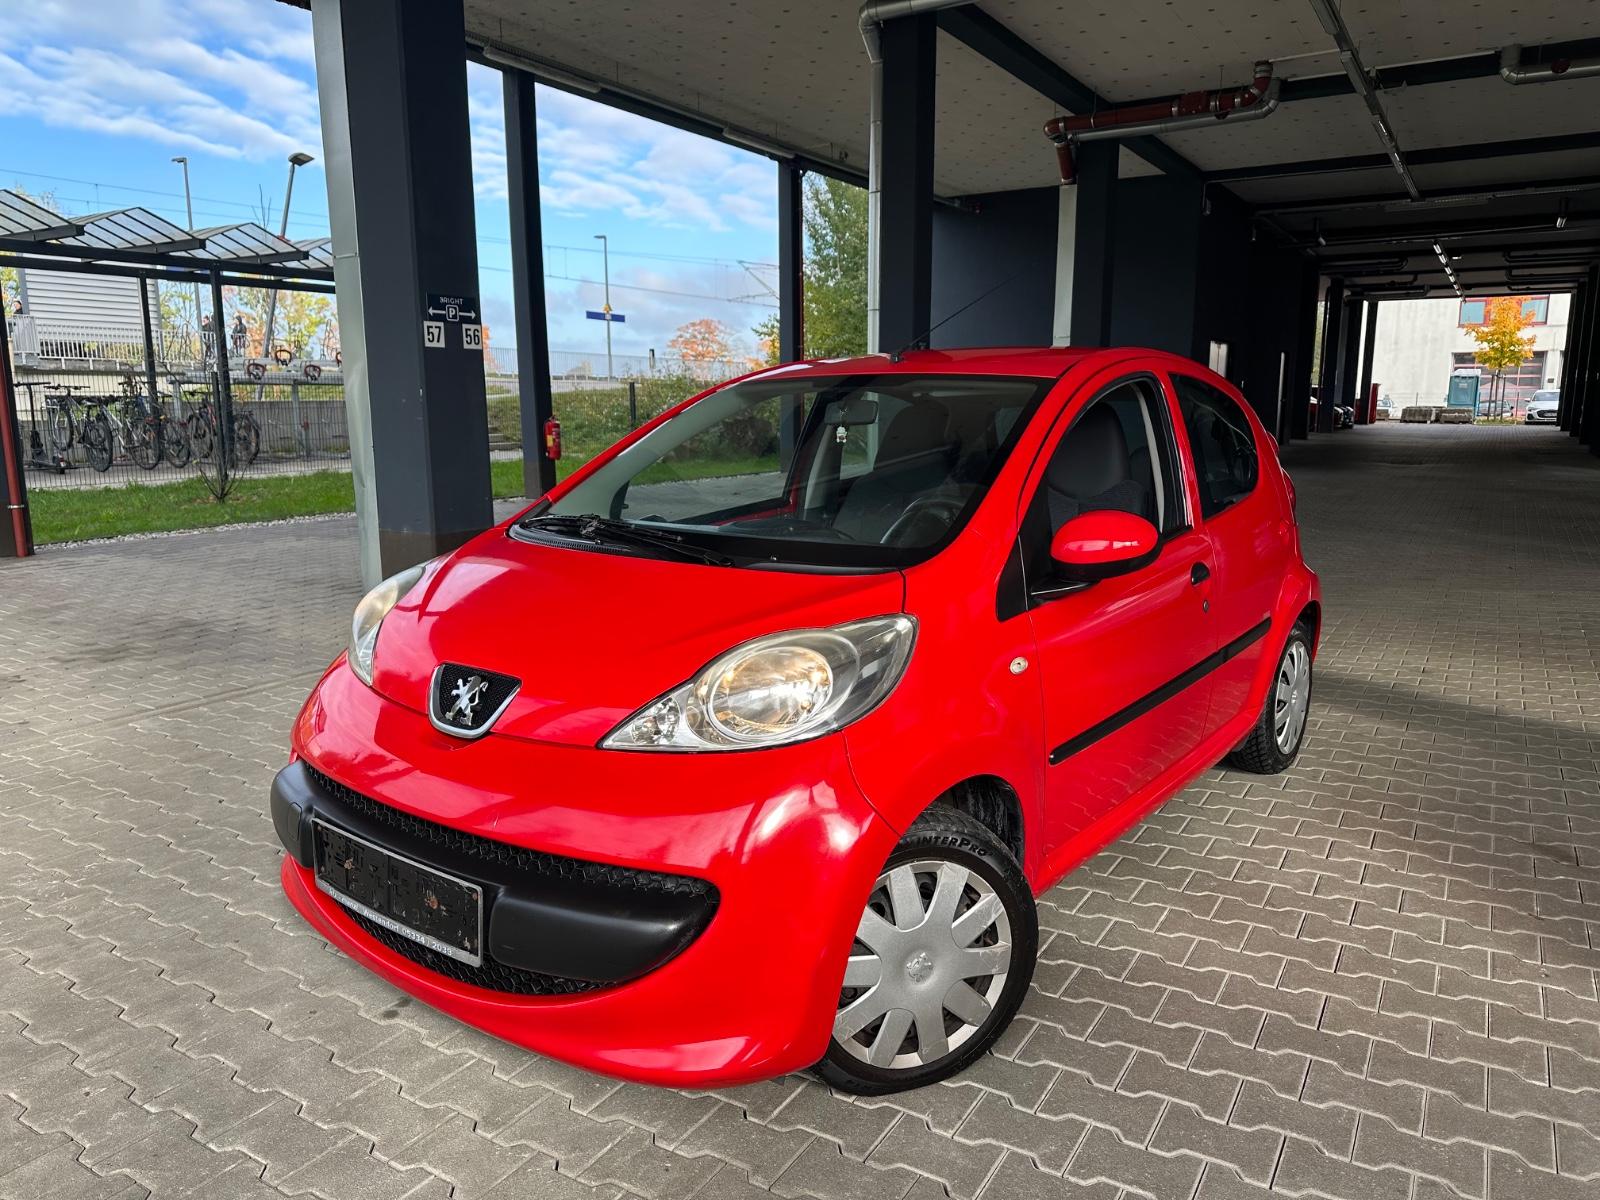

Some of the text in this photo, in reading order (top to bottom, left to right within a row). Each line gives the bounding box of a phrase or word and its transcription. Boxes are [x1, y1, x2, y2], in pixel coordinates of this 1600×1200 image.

[448, 308, 456, 318] P
[426, 325, 442, 343] 57
[464, 328, 480, 346] 56
